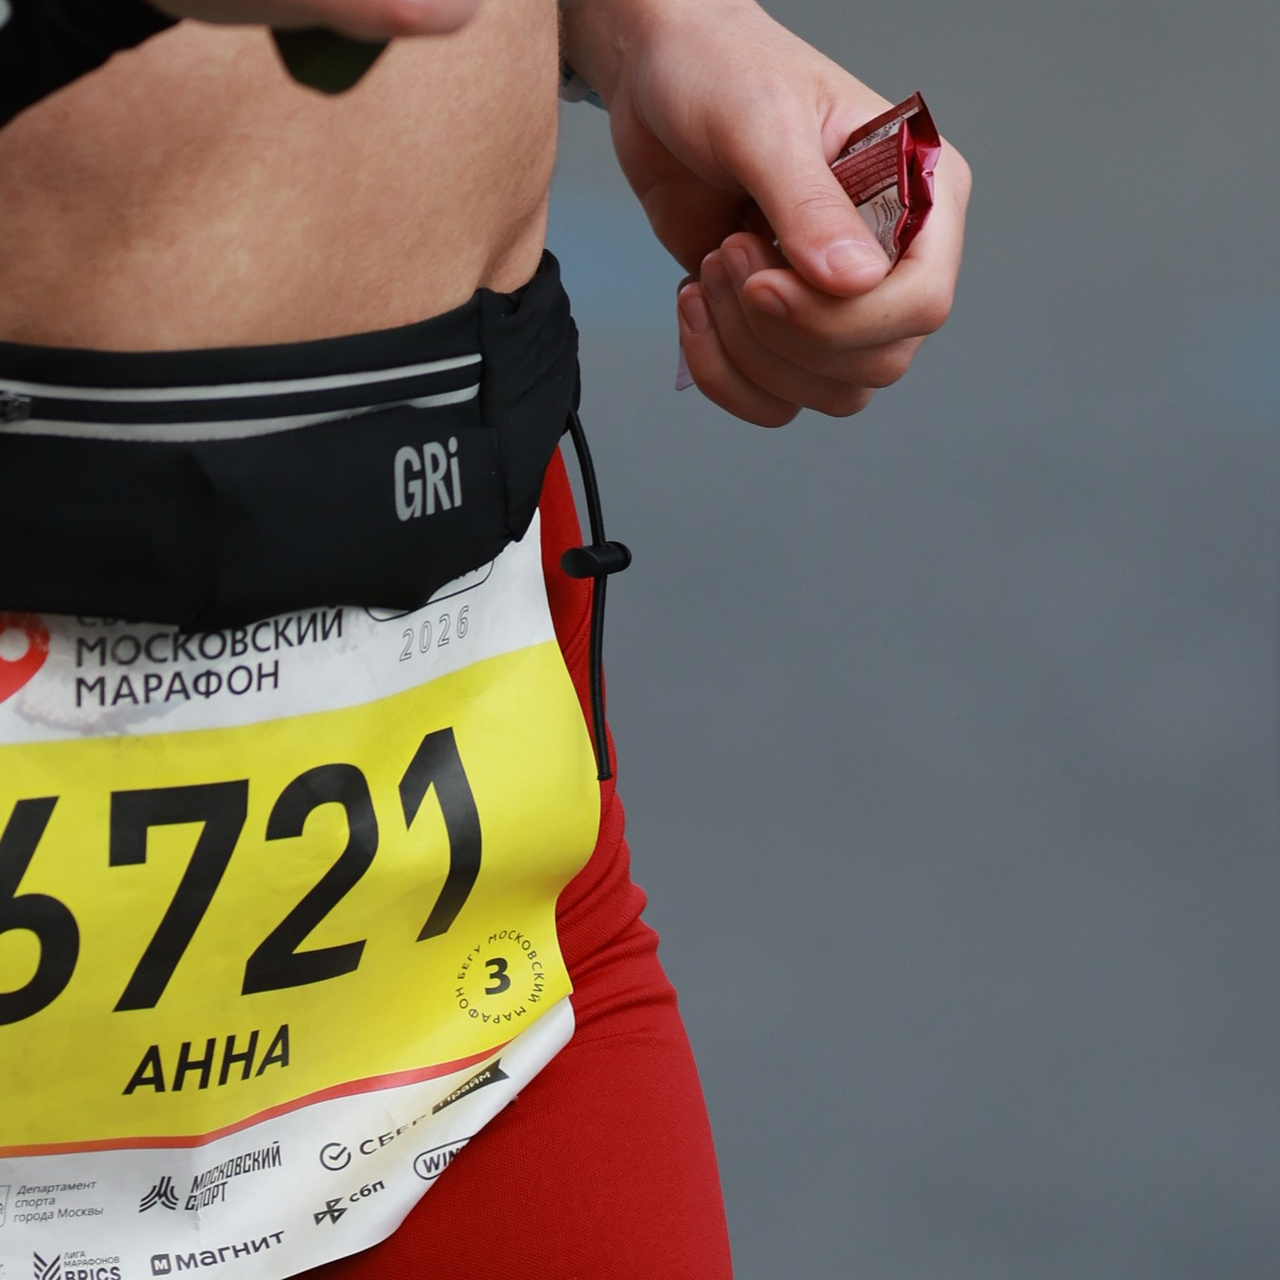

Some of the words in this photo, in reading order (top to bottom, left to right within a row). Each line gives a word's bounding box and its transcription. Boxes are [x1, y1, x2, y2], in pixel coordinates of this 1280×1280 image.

[394, 436, 462, 521] GRi
[76, 606, 344, 668] МОСКОВСКИЙ
[399, 605, 470, 663] 2026
[76, 660, 280, 707] МАРАФОН
[485, 957, 511, 995] 3
[488, 930, 544, 1003] МОСКОВСКИЙ
[455, 987, 527, 1024] МАРАФОН
[122, 1025, 290, 1096] АННА
[190, 1141, 282, 1193] МОСКОВСКИЙ
[15, 1196, 56, 1209] спорта
[16, 1181, 98, 1197] Департамент
[184, 1181, 228, 1211] СПОРТ
[14, 1211, 54, 1224] города
[57, 1207, 104, 1219] Москвы
[64, 1250, 86, 1259] ЛИГА
[64, 1256, 120, 1268] МАРАФОНОВ
[65, 1266, 122, 1280] BRICS
